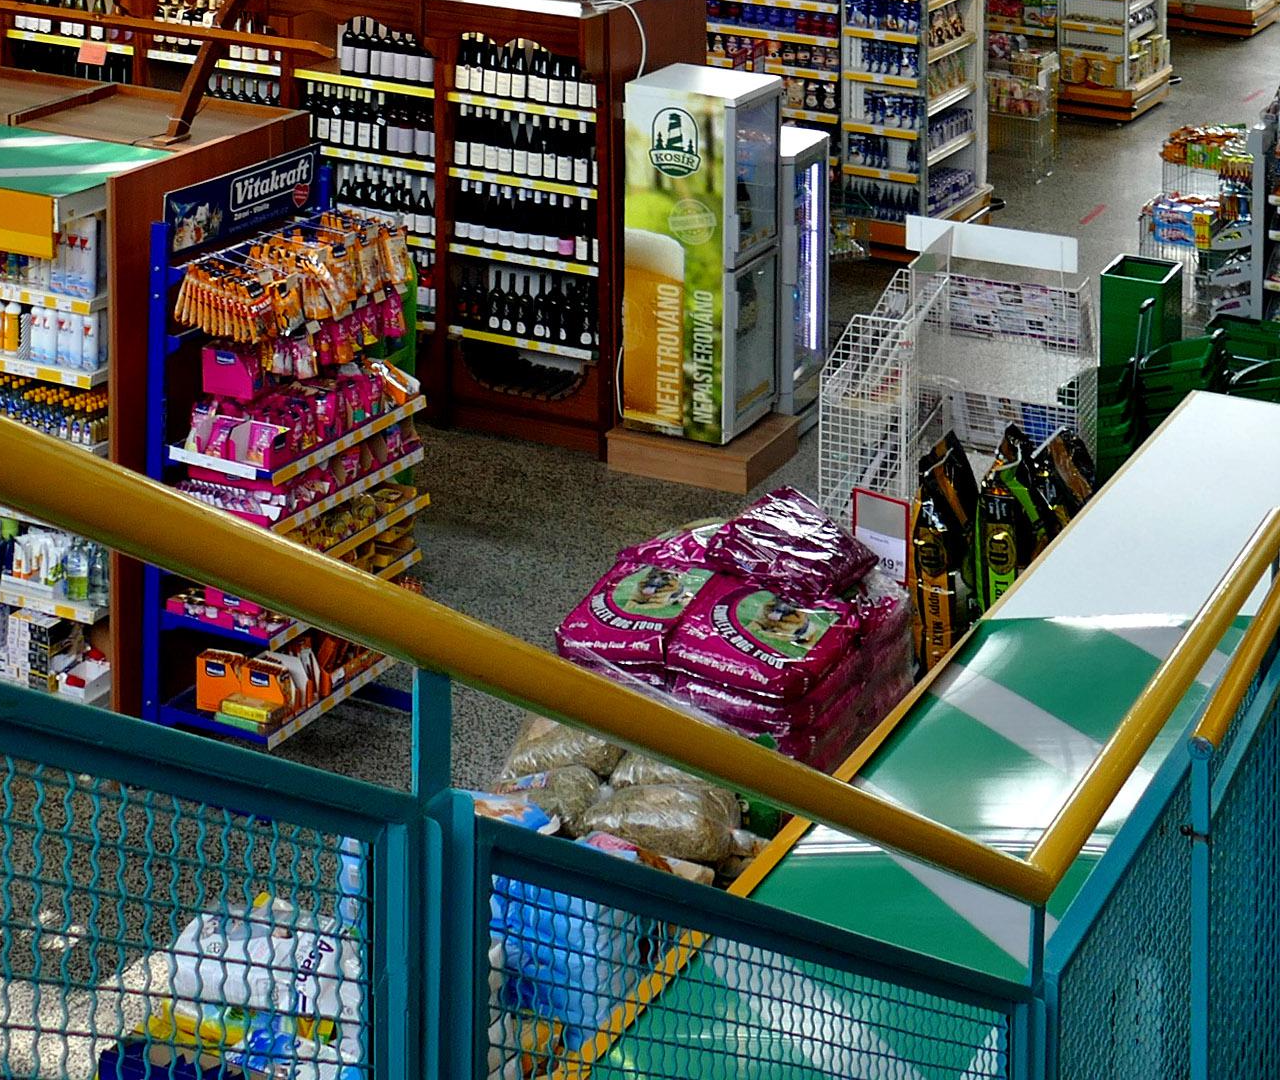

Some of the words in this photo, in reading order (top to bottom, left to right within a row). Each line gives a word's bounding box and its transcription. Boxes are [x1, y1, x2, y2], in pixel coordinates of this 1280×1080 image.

[654, 152, 695, 167] KOSÍŘ
[235, 159, 309, 204] Vitakraft
[652, 284, 680, 418] NEFILTROVÁNO
[689, 290, 714, 424] NEPASTEROVÁNO
[610, 617, 632, 629] DOG
[632, 621, 663, 631] FOOD
[730, 635, 754, 652] DOG
[753, 649, 784, 669] FOOD
